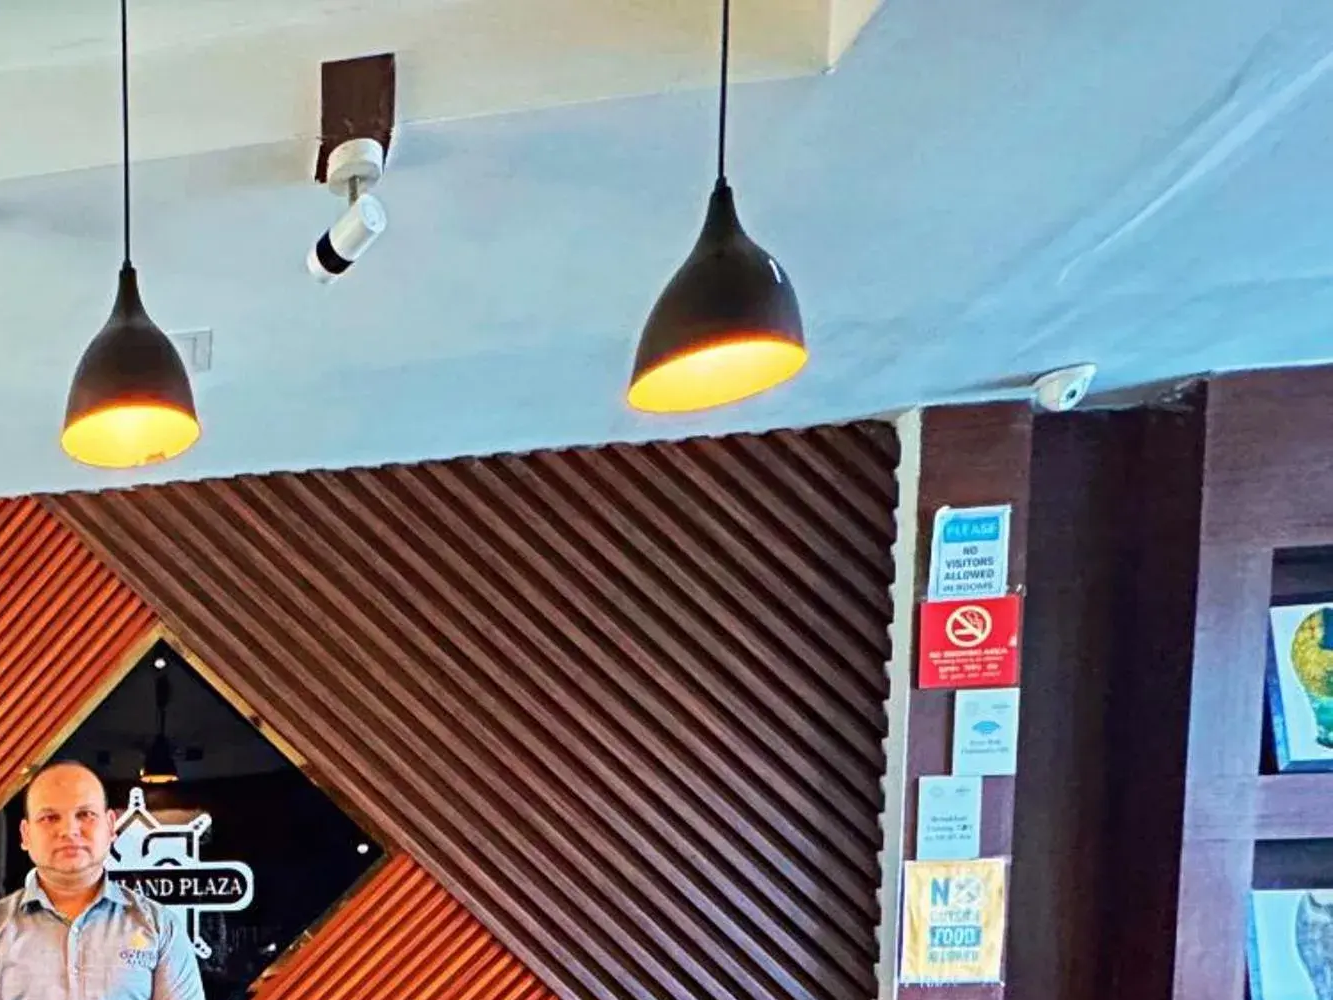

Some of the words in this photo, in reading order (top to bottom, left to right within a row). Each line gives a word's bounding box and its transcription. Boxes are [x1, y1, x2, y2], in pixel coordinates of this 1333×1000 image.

[962, 545, 979, 556] NO
[945, 556, 995, 569] VISITORS
[944, 568, 995, 581] ALLOWED
[179, 877, 244, 897] PLAZA
